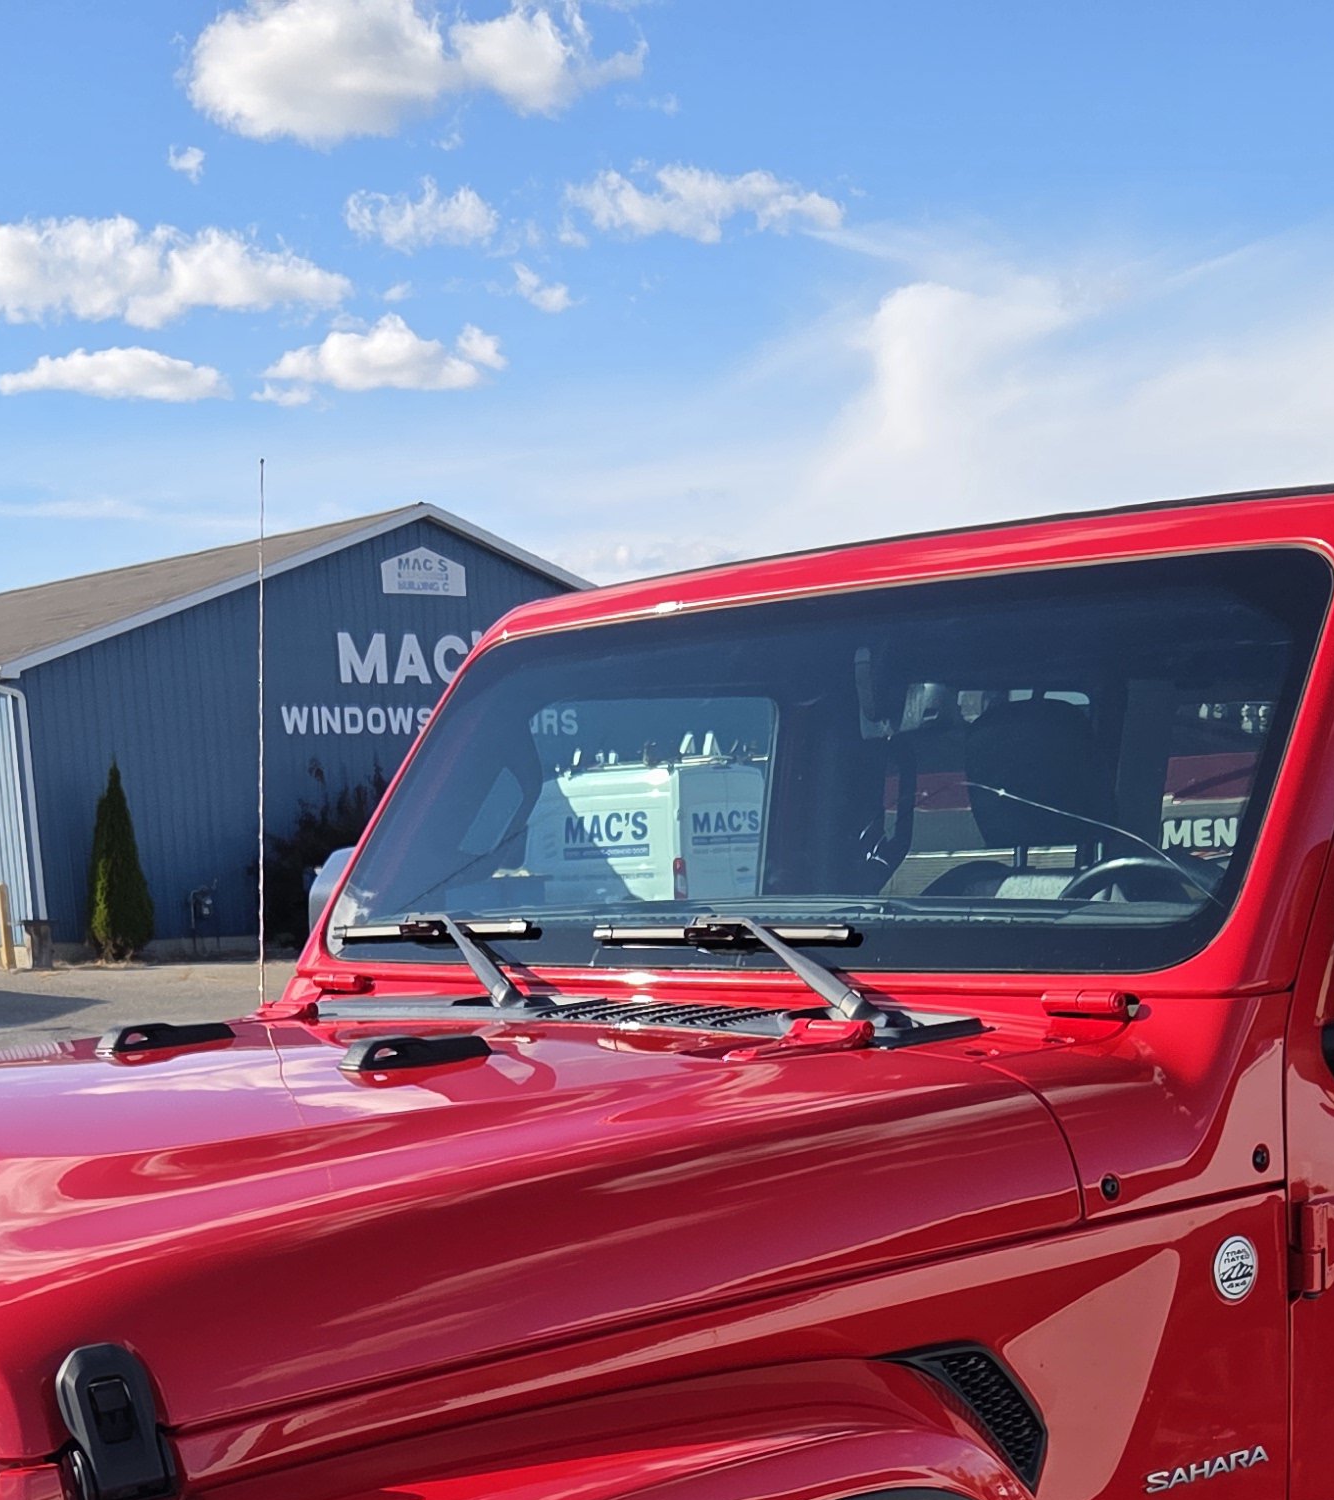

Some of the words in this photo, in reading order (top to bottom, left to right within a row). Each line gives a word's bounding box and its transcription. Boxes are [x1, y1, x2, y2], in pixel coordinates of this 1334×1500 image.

[565, 811, 648, 844] MAC'S
[692, 810, 759, 833] MAC'S
[1162, 818, 1238, 850] MEN
[1145, 1446, 1269, 1494] SAHARA
